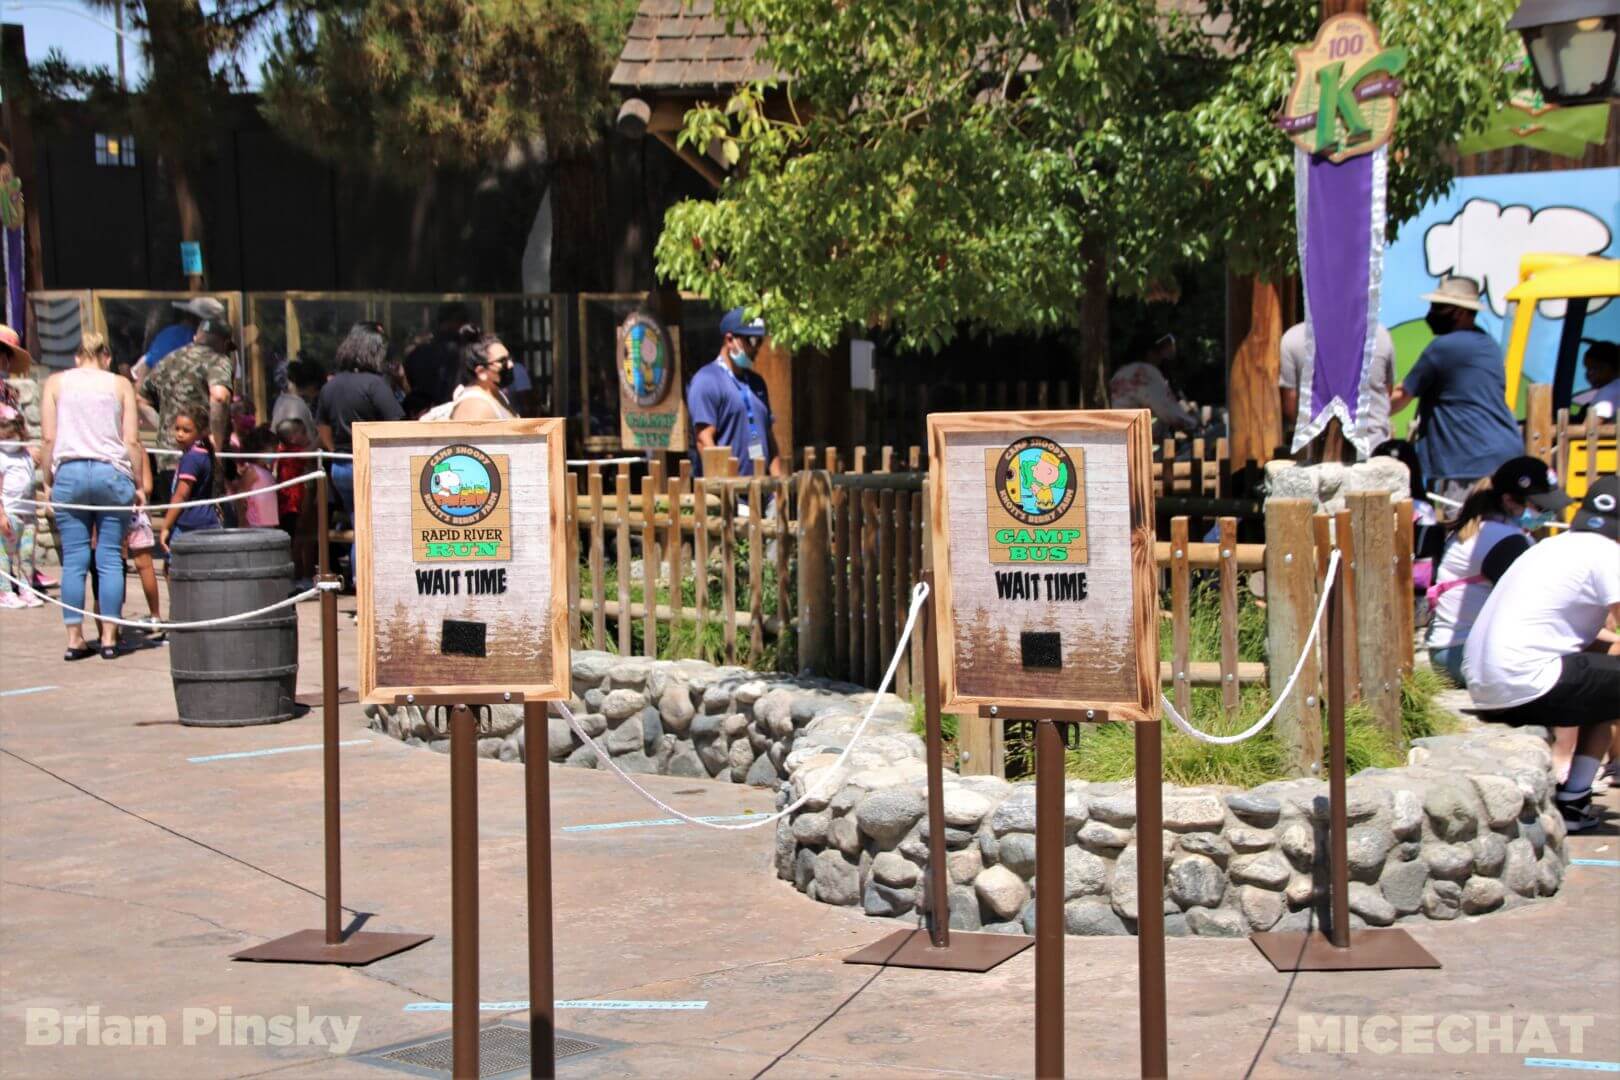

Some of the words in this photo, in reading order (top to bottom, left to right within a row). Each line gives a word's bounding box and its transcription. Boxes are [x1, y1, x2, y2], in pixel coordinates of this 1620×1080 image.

[1328, 34, 1365, 60] 100
[1316, 45, 1409, 152] K
[430, 447, 453, 466] CAMP
[455, 447, 491, 464] SNOOPY
[1030, 439, 1066, 458] SNOOPY
[422, 529, 460, 542] RAPID
[464, 529, 503, 541] RIVER
[995, 528, 1081, 544] CAMP
[426, 541, 501, 557] RUN
[1008, 546, 1068, 561] BUS
[415, 568, 461, 596] WAIT
[464, 568, 507, 596] TIME
[995, 570, 1041, 601] WAIT
[1044, 571, 1088, 602] TIME
